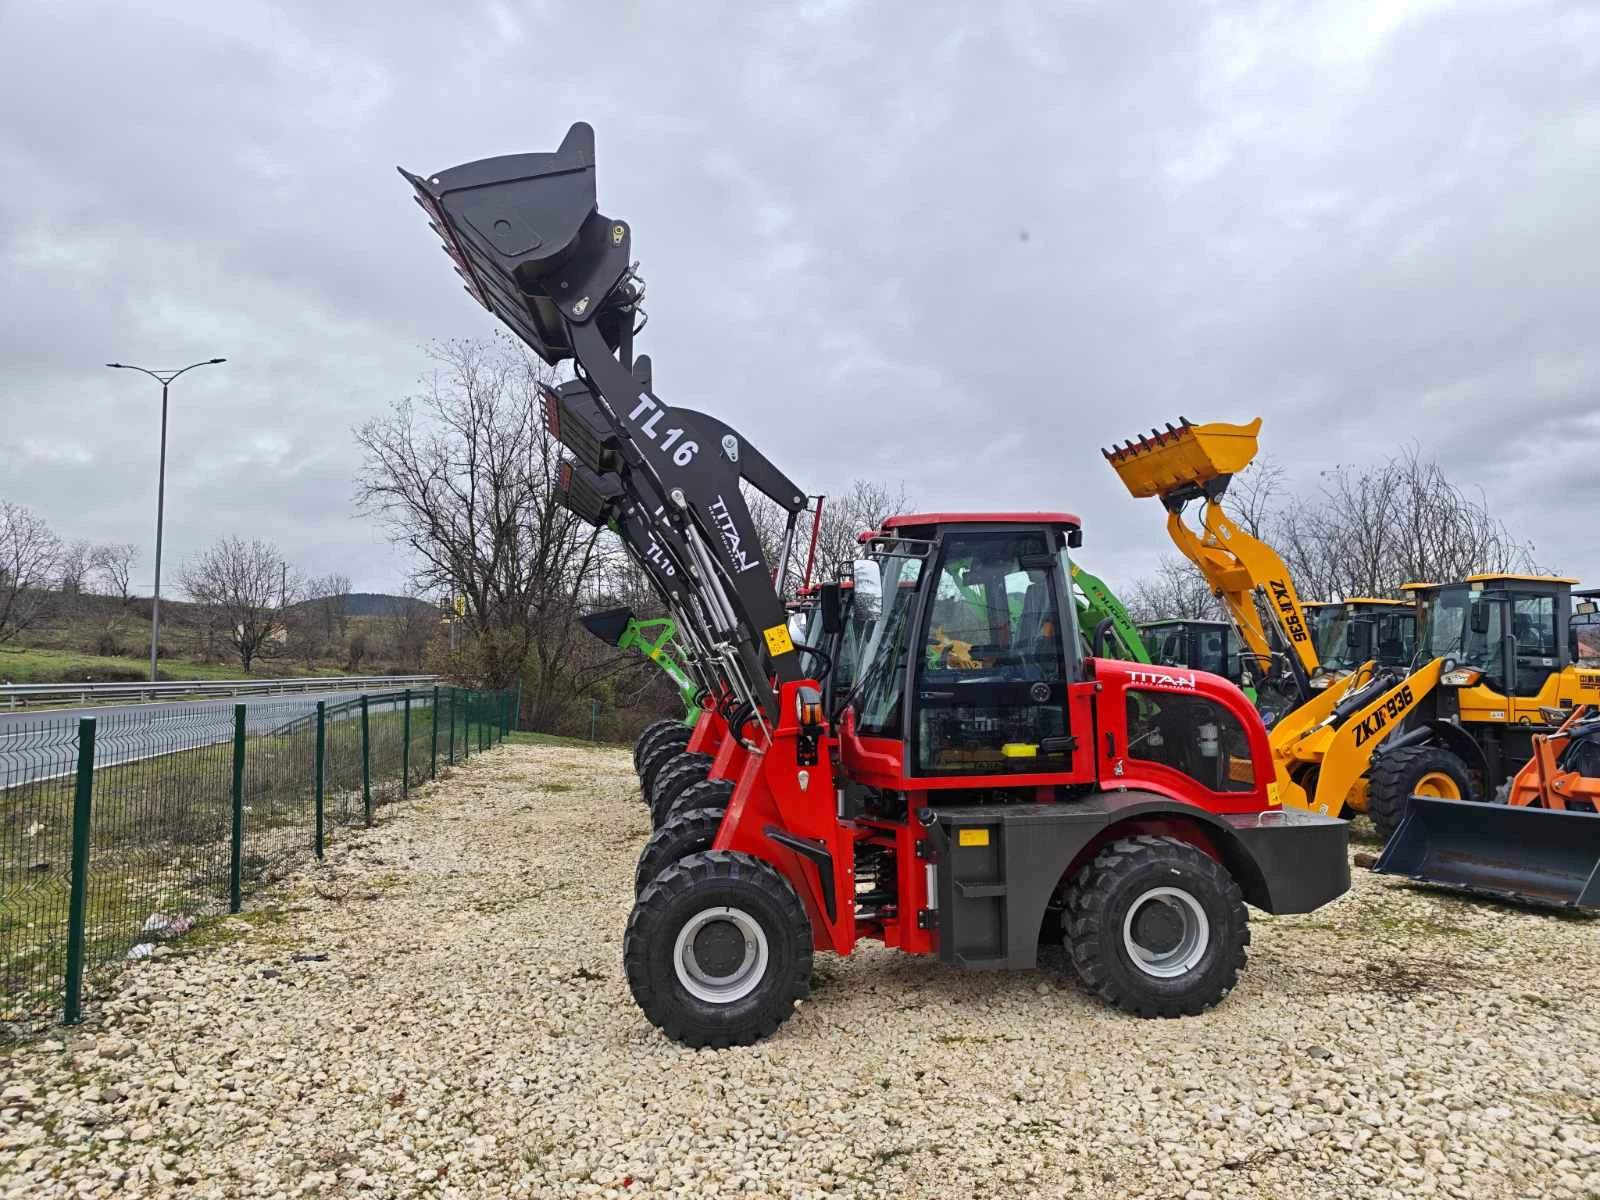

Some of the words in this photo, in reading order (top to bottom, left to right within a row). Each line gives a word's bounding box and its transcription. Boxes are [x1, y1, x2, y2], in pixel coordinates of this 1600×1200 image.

[628, 392, 699, 466] TL16
[712, 494, 760, 571] TITAN
[1124, 671, 1196, 688] TITAN
